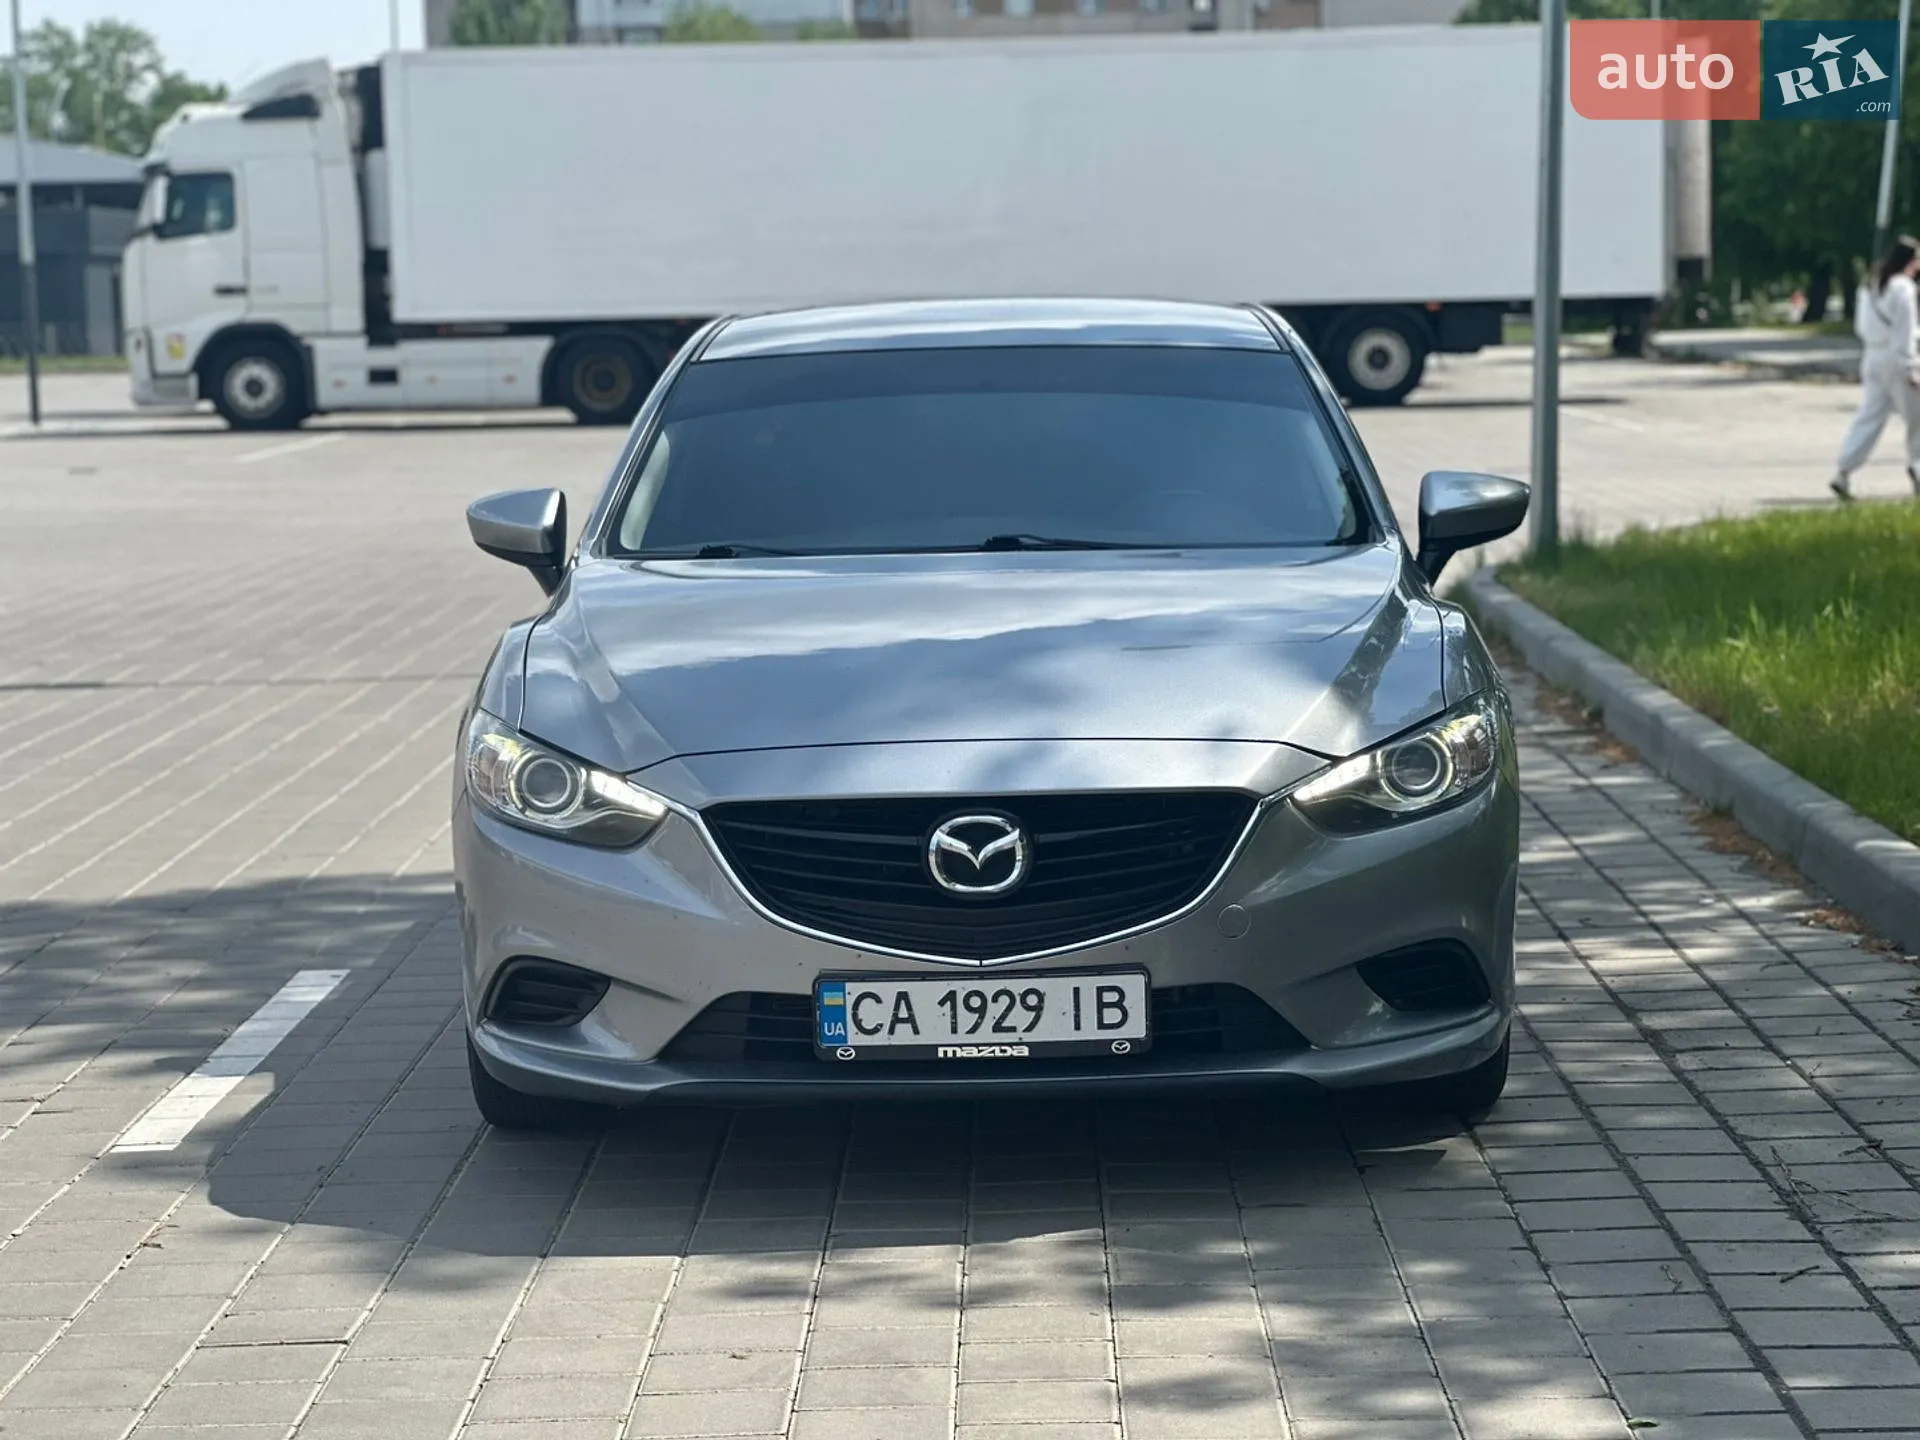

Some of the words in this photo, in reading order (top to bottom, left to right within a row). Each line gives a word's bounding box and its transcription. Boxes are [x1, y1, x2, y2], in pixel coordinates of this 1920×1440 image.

[851, 990, 920, 1036] CA
[937, 988, 1045, 1035] 1929
[1072, 985, 1129, 1032] IB
[824, 1021, 846, 1037] UA
[937, 1044, 1030, 1059] mazda
